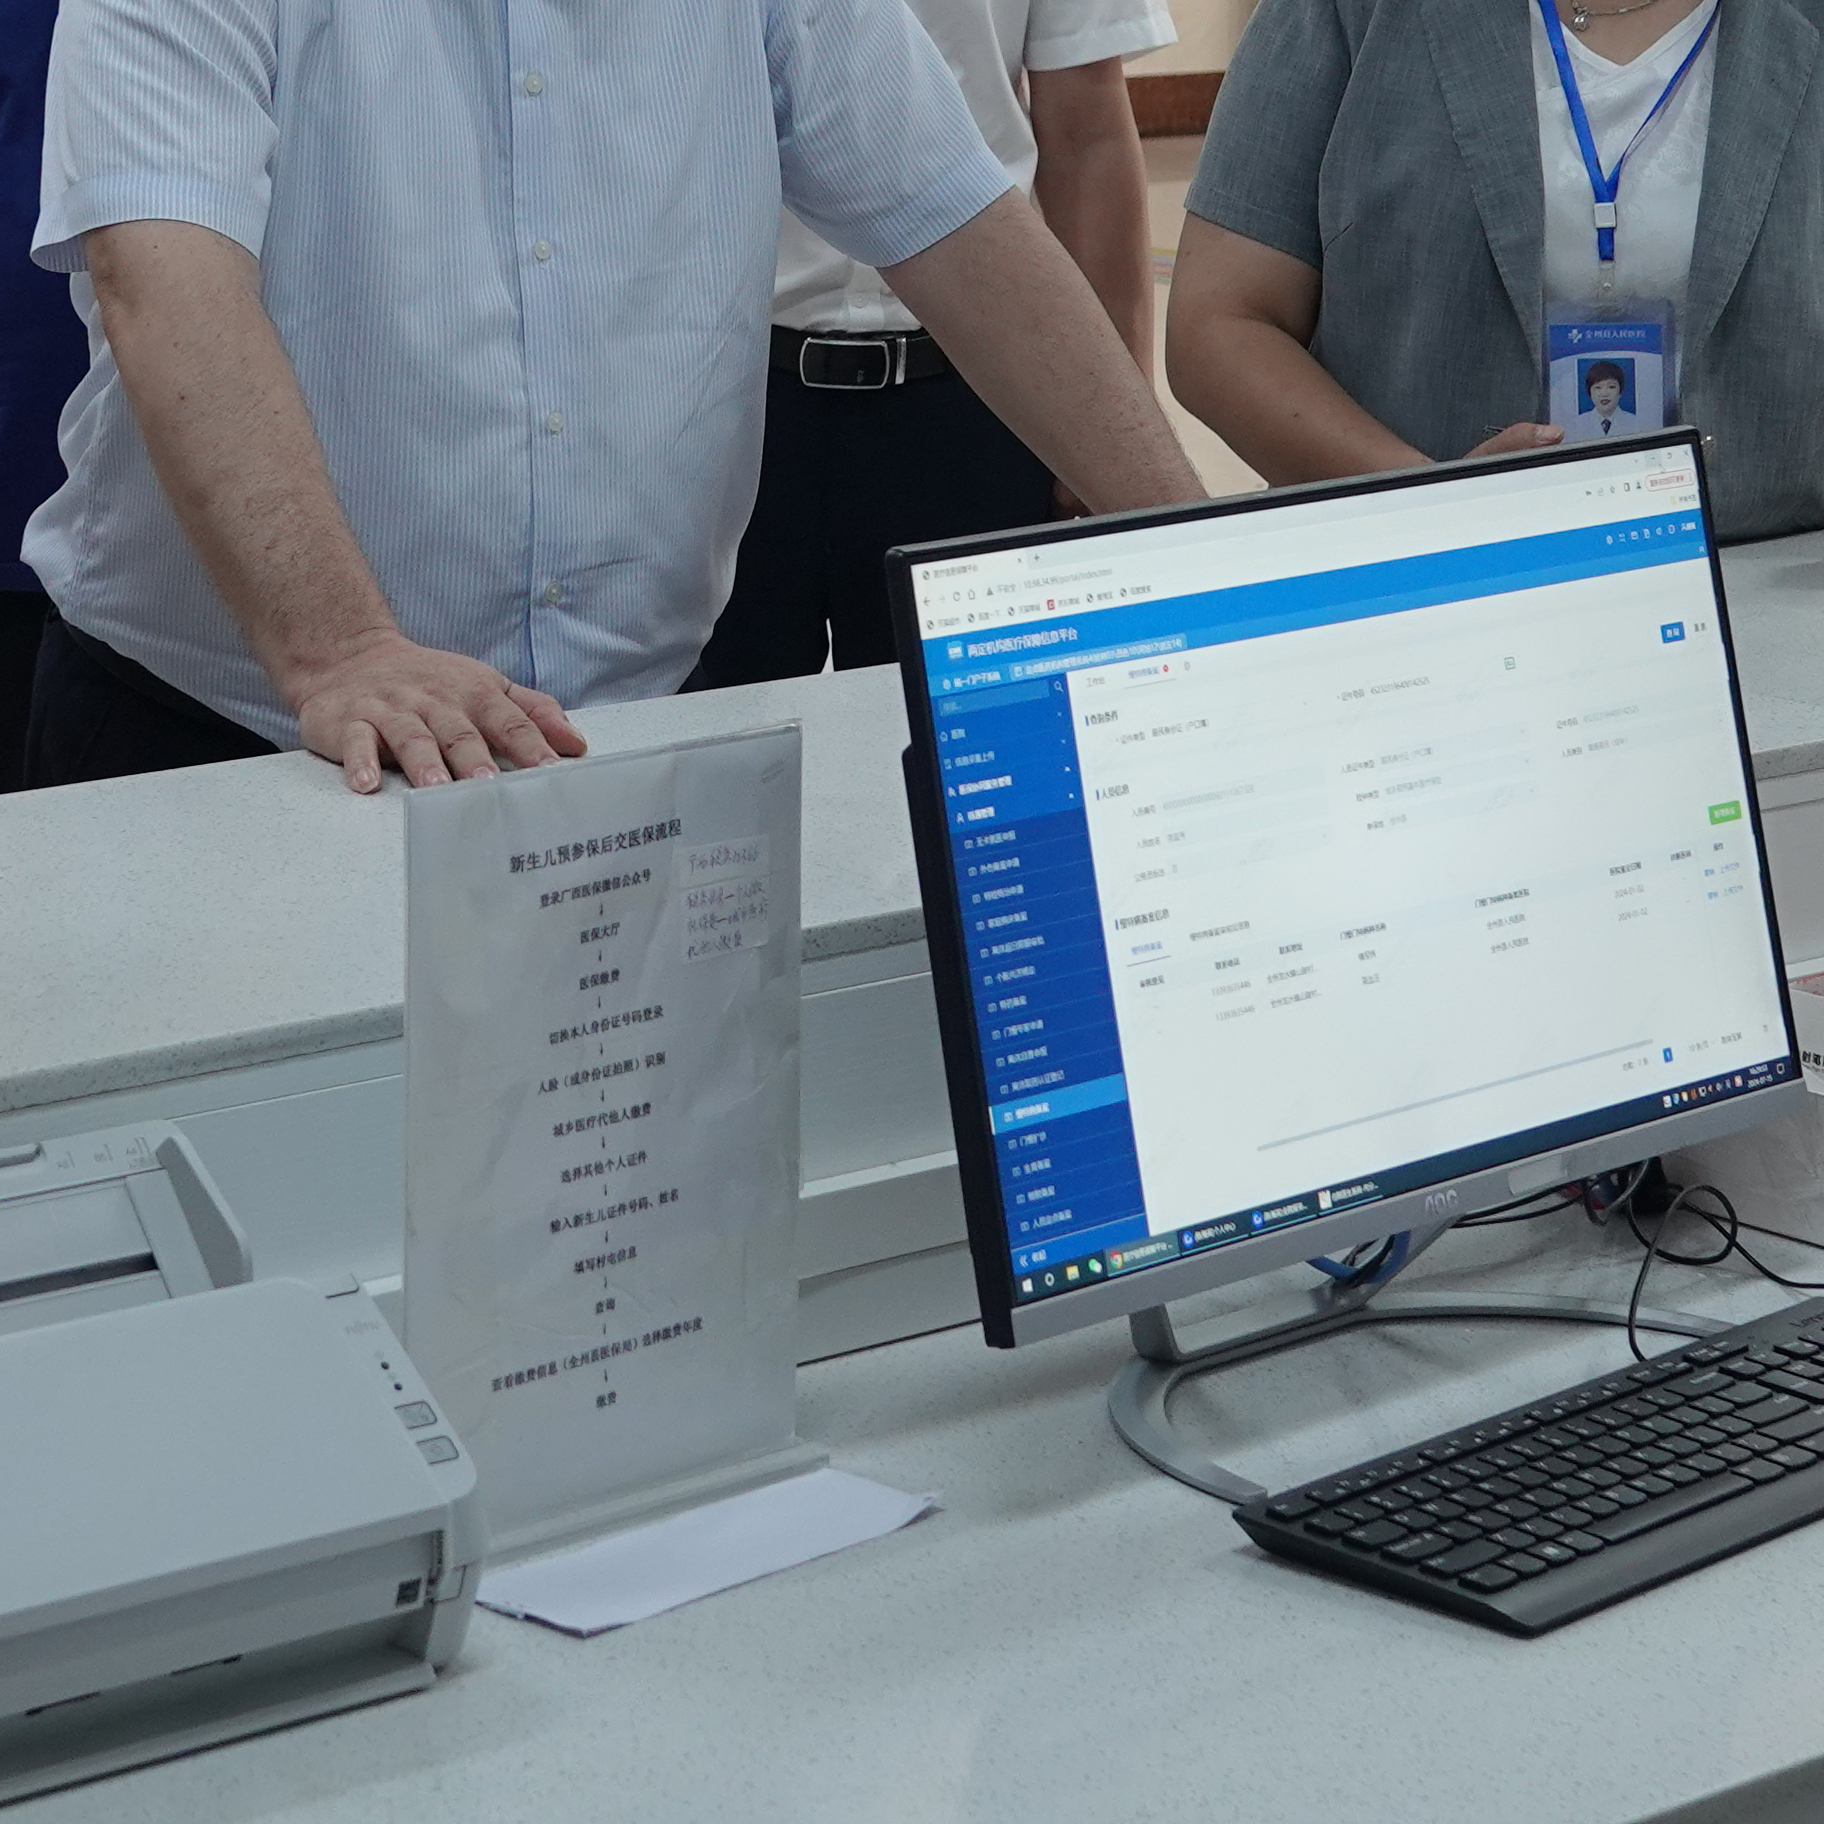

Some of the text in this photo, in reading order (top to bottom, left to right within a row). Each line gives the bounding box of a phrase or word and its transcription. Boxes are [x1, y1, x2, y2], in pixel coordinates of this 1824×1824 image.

[510, 819, 682, 874] 新生儿预参保后交医保流程
[540, 868, 652, 909] 登录广西医保微信公众号
[580, 922, 620, 944] 医保大厅
[579, 968, 620, 991] 医保缴费
[549, 1005, 664, 1045] 切换本人身份证号码登录
[552, 1102, 652, 1138] 城乡医疗代他人缴费
[560, 1150, 648, 1184] 选择其他个人证件
[574, 1245, 638, 1274] 填写村屯信息
[595, 1297, 616, 1316] 查询
[595, 1390, 617, 1409] 缴费
